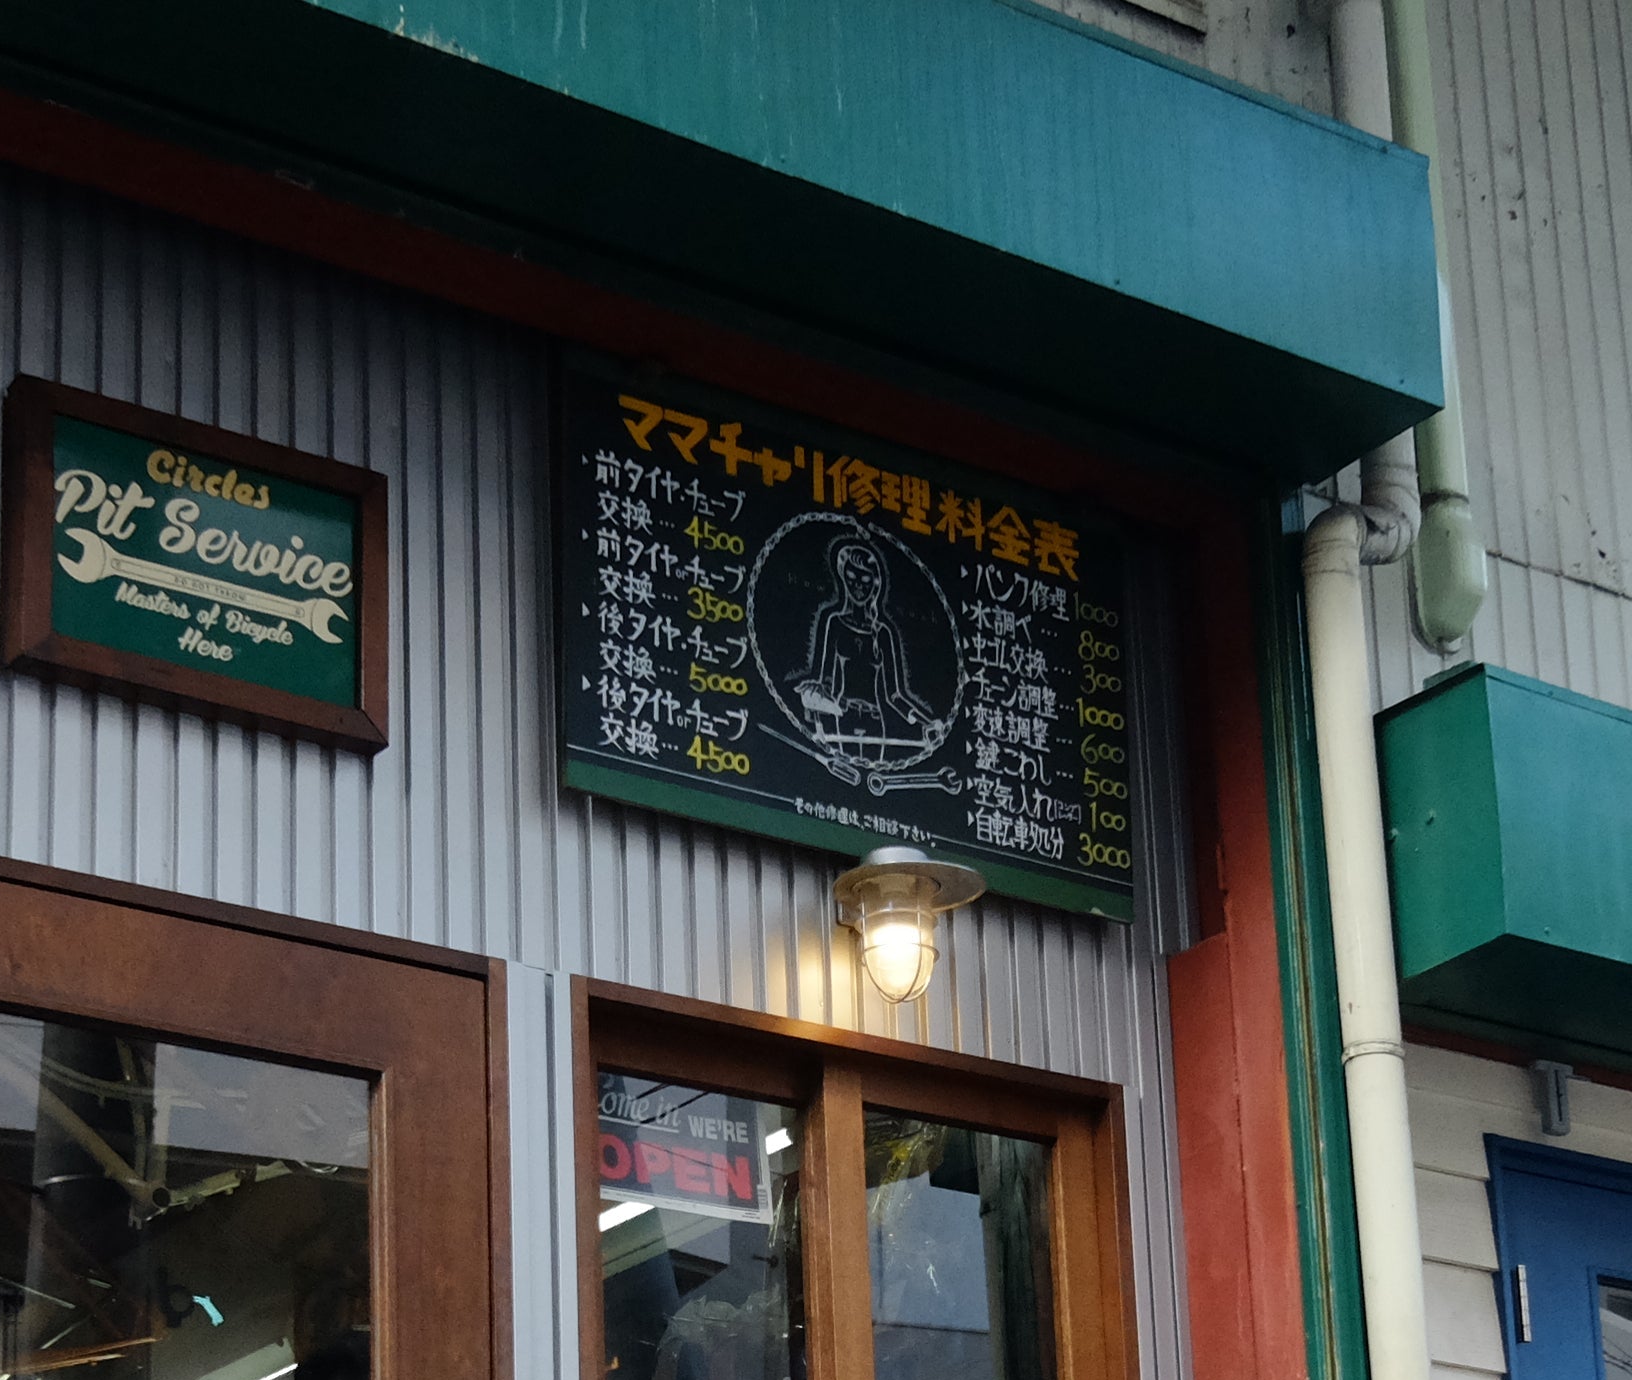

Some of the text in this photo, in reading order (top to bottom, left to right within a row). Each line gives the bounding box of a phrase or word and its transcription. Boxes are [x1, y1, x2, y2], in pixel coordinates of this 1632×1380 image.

[146, 449, 270, 510] Circles
[618, 394, 1080, 581] ママチャリ修理料金表
[54, 468, 354, 598] Pit Service
[683, 515, 745, 556] 4500
[115, 581, 294, 646] Masters of Bicycle
[686, 586, 745, 624] 3500
[974, 562, 1120, 628] パンク修理 1000
[178, 627, 234, 662] Here
[1077, 629, 1121, 662] 800
[688, 662, 749, 697] 5000
[1080, 663, 1122, 695] 300
[1075, 696, 1125, 732] 1000
[686, 734, 751, 776] 4500
[1080, 732, 1125, 765] 600
[1082, 767, 1129, 801] 500
[1088, 800, 1127, 834] 100
[973, 807, 1065, 861] 自転車処分
[1077, 832, 1131, 871] 3000
[598, 1091, 650, 1119] ome
[688, 1114, 750, 1145] WE'RE
[598, 1132, 753, 1200] OPEN
